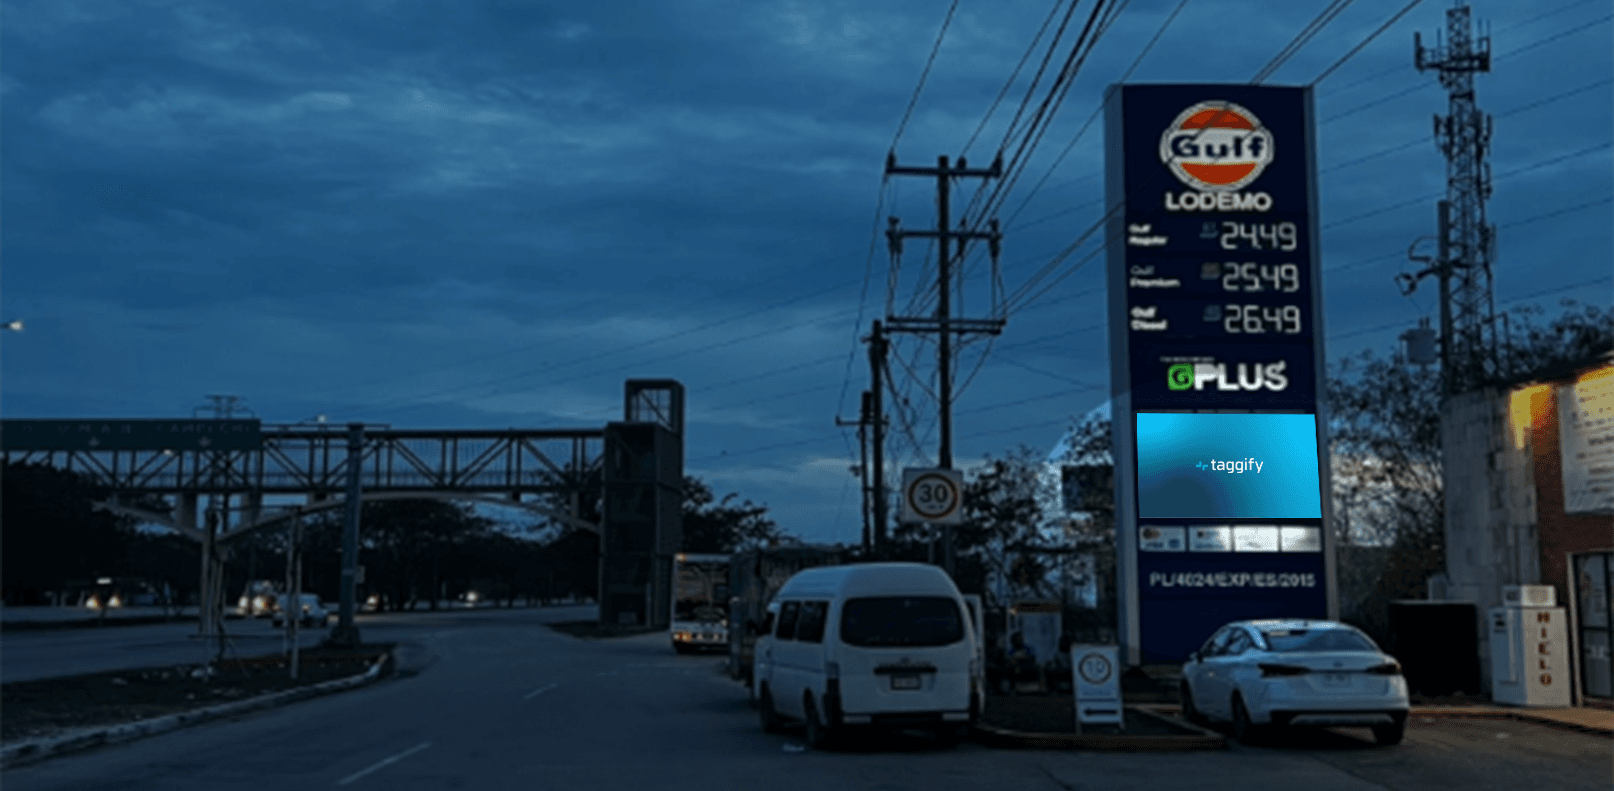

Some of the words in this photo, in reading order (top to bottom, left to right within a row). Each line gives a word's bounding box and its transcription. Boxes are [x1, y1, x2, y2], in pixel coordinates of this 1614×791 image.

[1171, 135, 1266, 158] Gulf
[1165, 192, 1272, 211] LODEMO
[1211, 458, 1263, 474] taggify
[919, 484, 948, 503] 30
